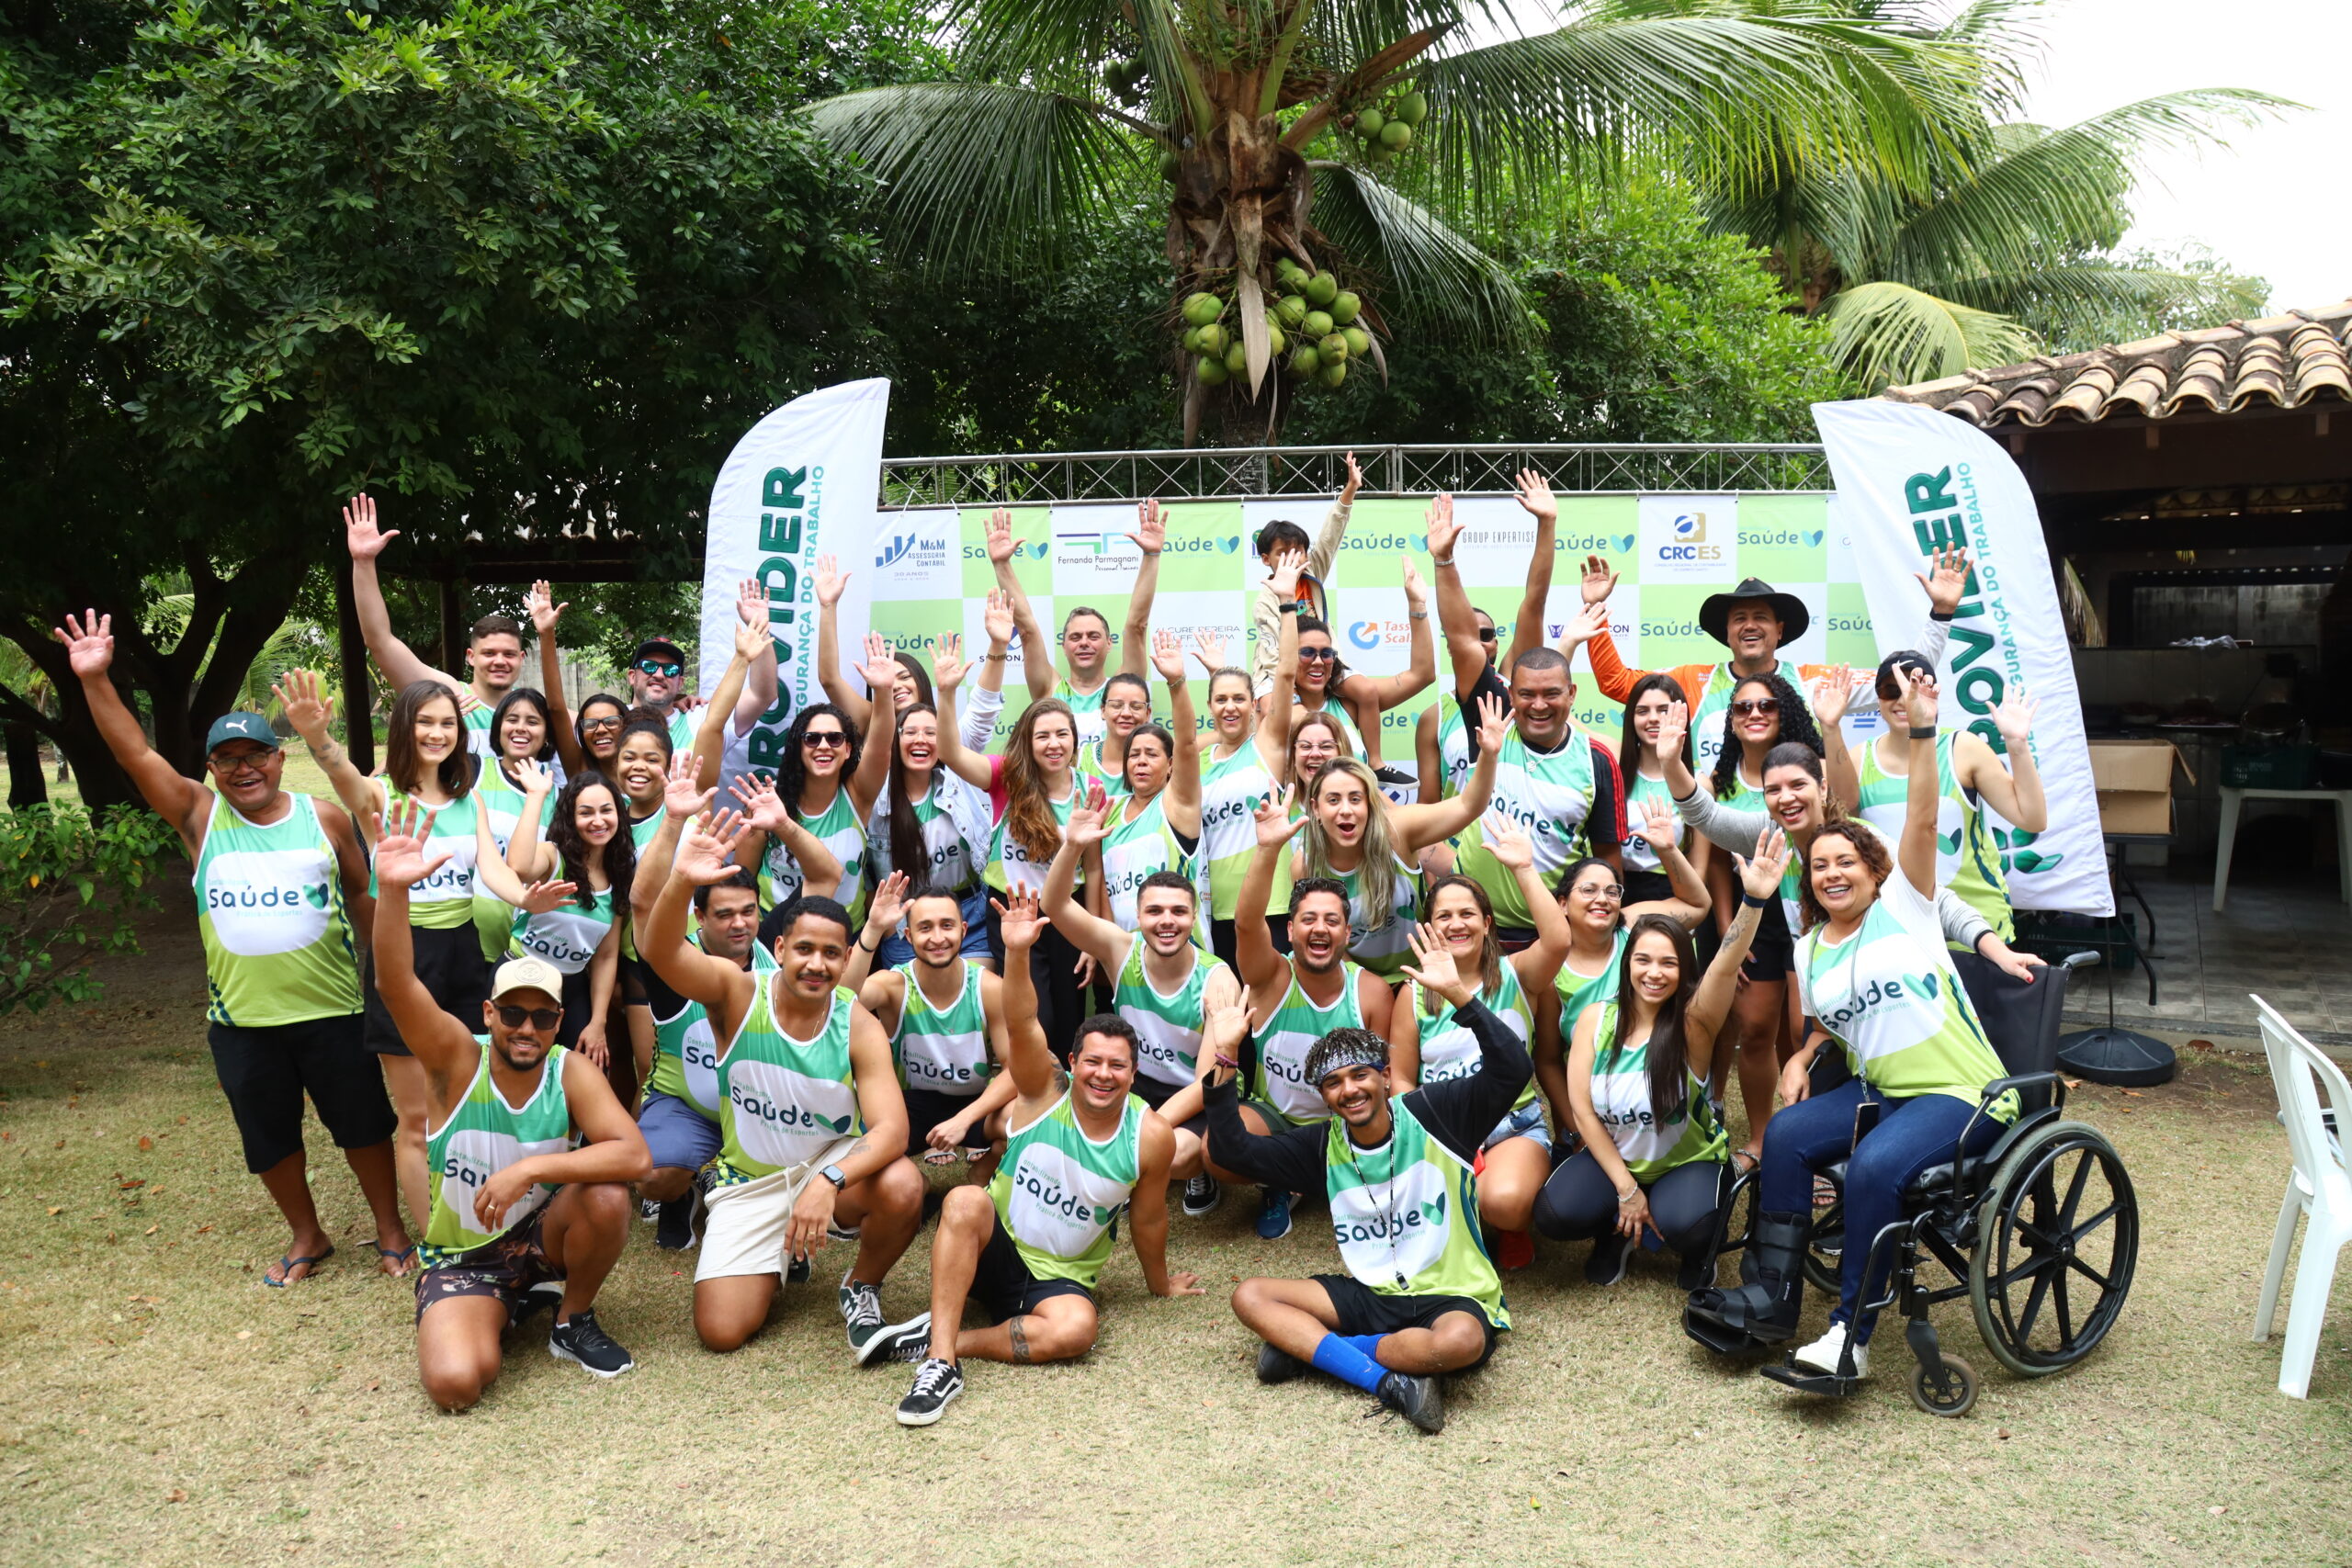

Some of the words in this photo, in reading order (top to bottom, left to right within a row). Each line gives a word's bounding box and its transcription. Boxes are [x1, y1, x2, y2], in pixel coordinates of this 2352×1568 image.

[804, 465, 824, 569] TRABALHO
[1957, 461, 1992, 560] TRABALHO
[920, 538, 945, 551] M&M
[1162, 536, 1213, 552] aúde
[1340, 534, 1406, 549] Saúde
[1463, 531, 1488, 544] GROUP
[1492, 530, 1535, 543] EXPERTISE
[1555, 535, 1607, 550] aúde
[1737, 529, 1799, 545] Saúde
[963, 546, 1023, 558] Sae
[1094, 555, 1139, 566] Parmagnani
[1982, 564, 2001, 592] DO
[800, 575, 814, 604] DO
[749, 465, 807, 788] ROIDER
[1384, 621, 1410, 631] Tass
[1640, 620, 1704, 637] Saúde
[1827, 616, 1873, 631] Saú
[870, 634, 934, 650] aúde
[1153, 715, 1215, 730] Sade
[209, 885, 300, 908] Saúde
[1138, 1038, 1174, 1063] úde
[732, 1085, 814, 1128] Saúde
[1023, 1159, 1062, 1187] ontabilizando
[1016, 1165, 1091, 1222] Saúde
[1334, 1210, 1421, 1245] Saúde
